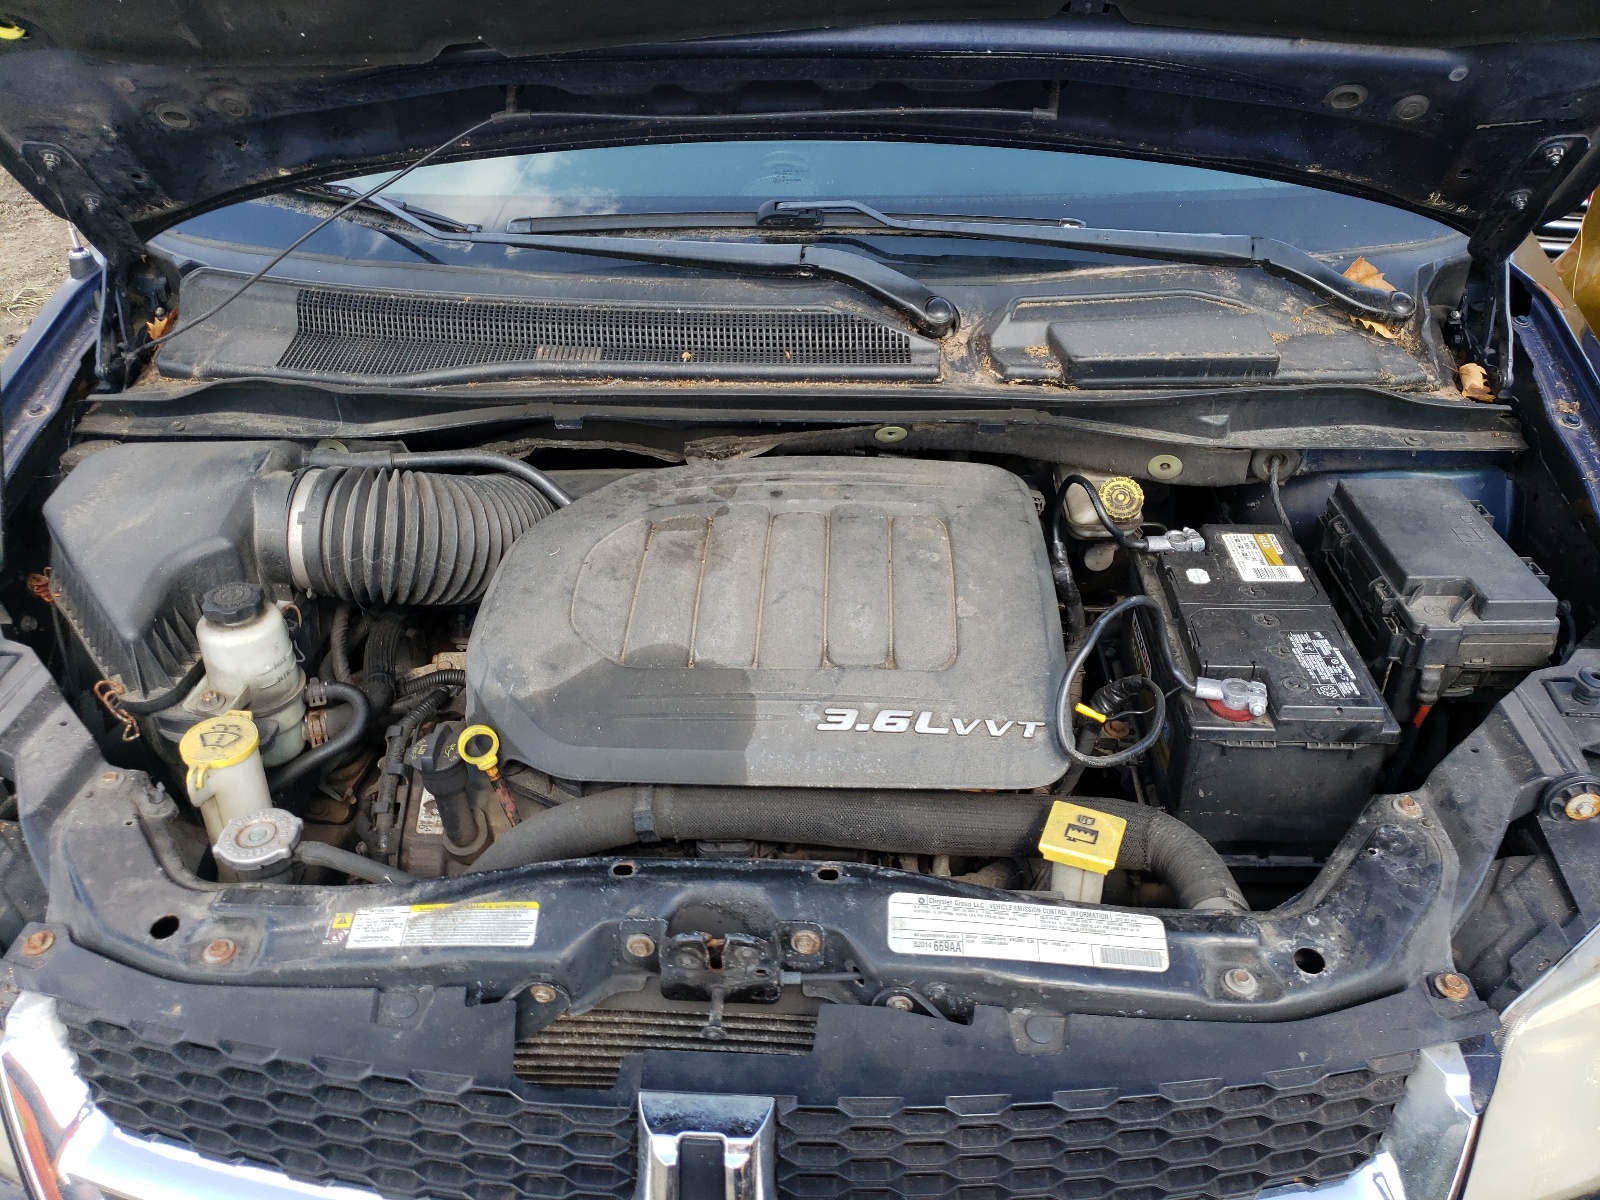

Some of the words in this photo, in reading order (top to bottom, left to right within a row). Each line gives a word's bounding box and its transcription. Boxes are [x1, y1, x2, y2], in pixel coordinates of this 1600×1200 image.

[928, 896, 953, 907] Chrysler
[954, 898, 972, 908] Group
[973, 901, 985, 909] LLC
[989, 903, 1013, 911] VEHICLE
[1014, 904, 1041, 914] EMISSION
[1042, 907, 1068, 916] CONTROL
[1070, 910, 1109, 920] INFORMATION
[933, 941, 962, 953] 669AA
